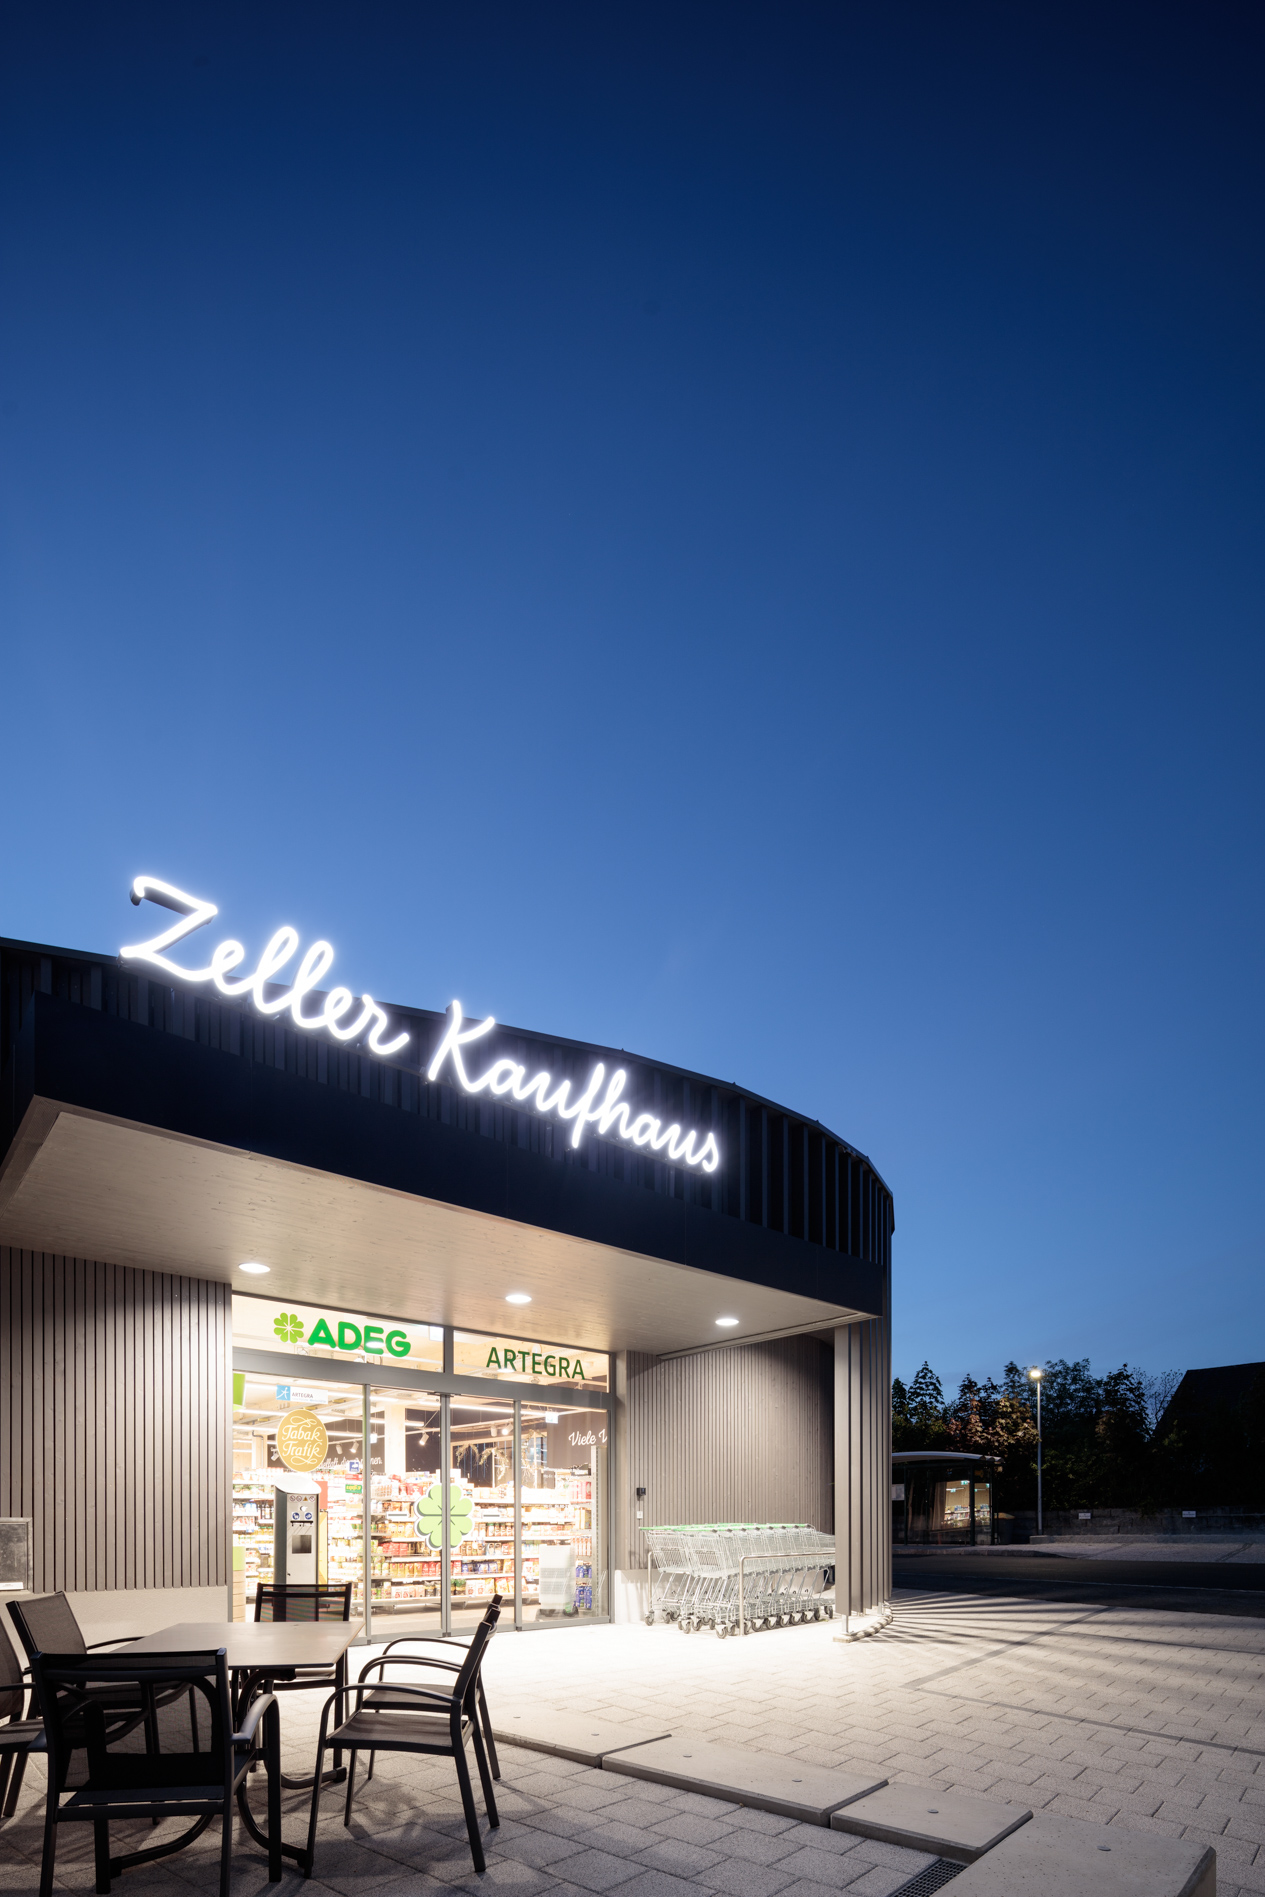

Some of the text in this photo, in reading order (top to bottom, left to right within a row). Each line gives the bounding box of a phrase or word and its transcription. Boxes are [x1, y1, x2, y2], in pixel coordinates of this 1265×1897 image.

[119, 875, 720, 1174] Zeller Kaufhaus
[307, 1318, 411, 1358] ADEG
[486, 1346, 586, 1381] ARTEGRA
[281, 1423, 323, 1442] Tabak
[568, 1430, 597, 1446] Viele
[282, 1440, 323, 1459] Trafik
